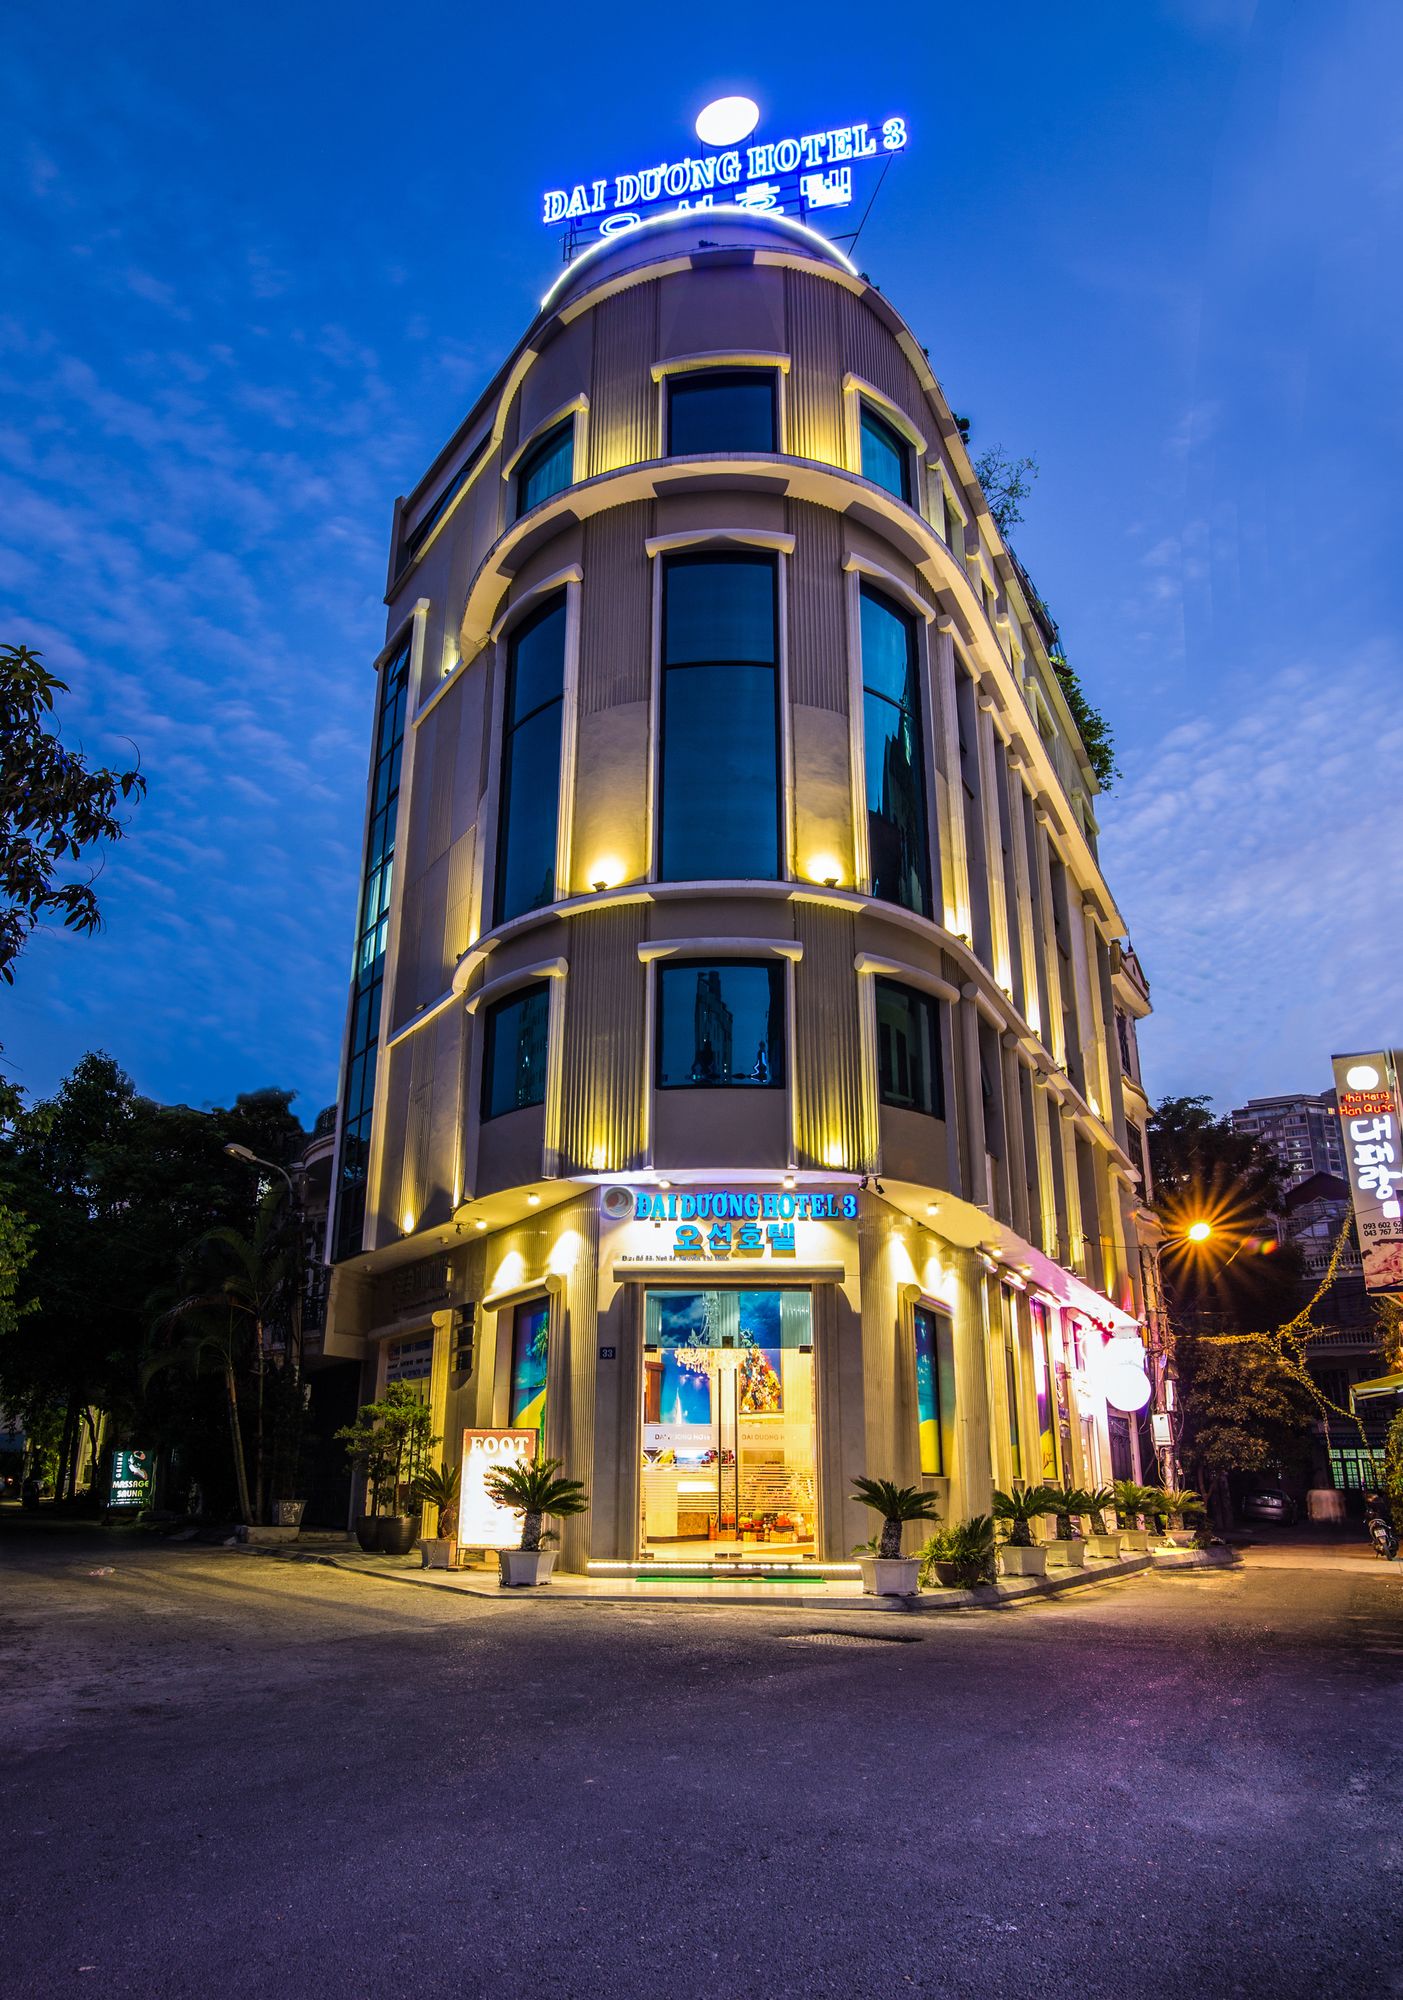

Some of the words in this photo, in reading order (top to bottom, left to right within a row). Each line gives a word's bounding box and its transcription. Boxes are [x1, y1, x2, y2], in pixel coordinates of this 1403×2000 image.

[747, 124, 876, 180] HOTEL
[882, 117, 907, 150] 3
[763, 1193, 839, 1219] HOTEL
[843, 1194, 858, 1219] 3
[673, 1223, 795, 1251] 오션호텔
[470, 1435, 529, 1455] FOOT
[112, 1480, 149, 1489] MASSAGE
[117, 1489, 143, 1498] SAUNA
